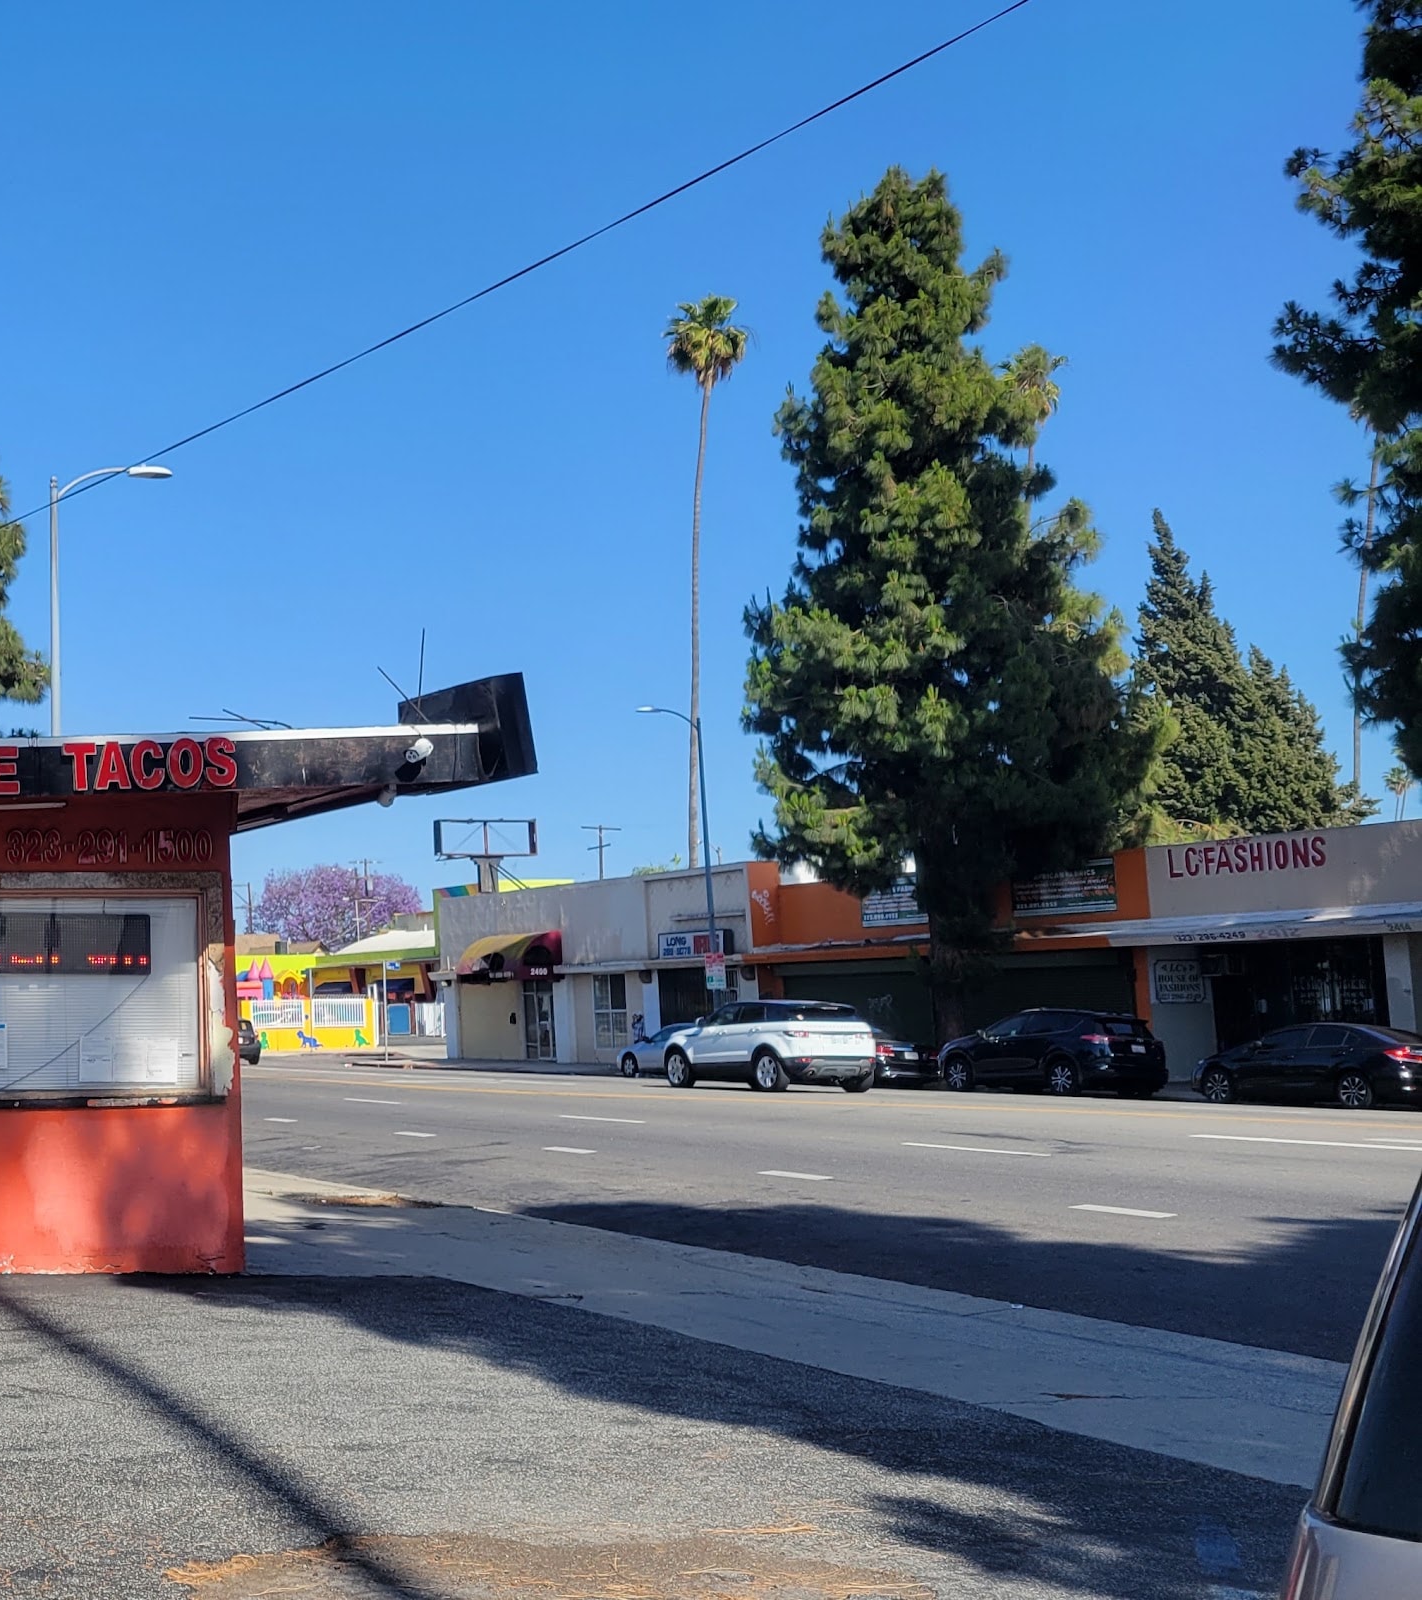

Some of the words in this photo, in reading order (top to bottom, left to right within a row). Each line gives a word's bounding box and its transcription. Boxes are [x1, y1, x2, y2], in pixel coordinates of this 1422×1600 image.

[63, 737, 237, 791] TACOS
[7, 829, 213, 865] 323-291-1500
[666, 936, 687, 947] LONG
